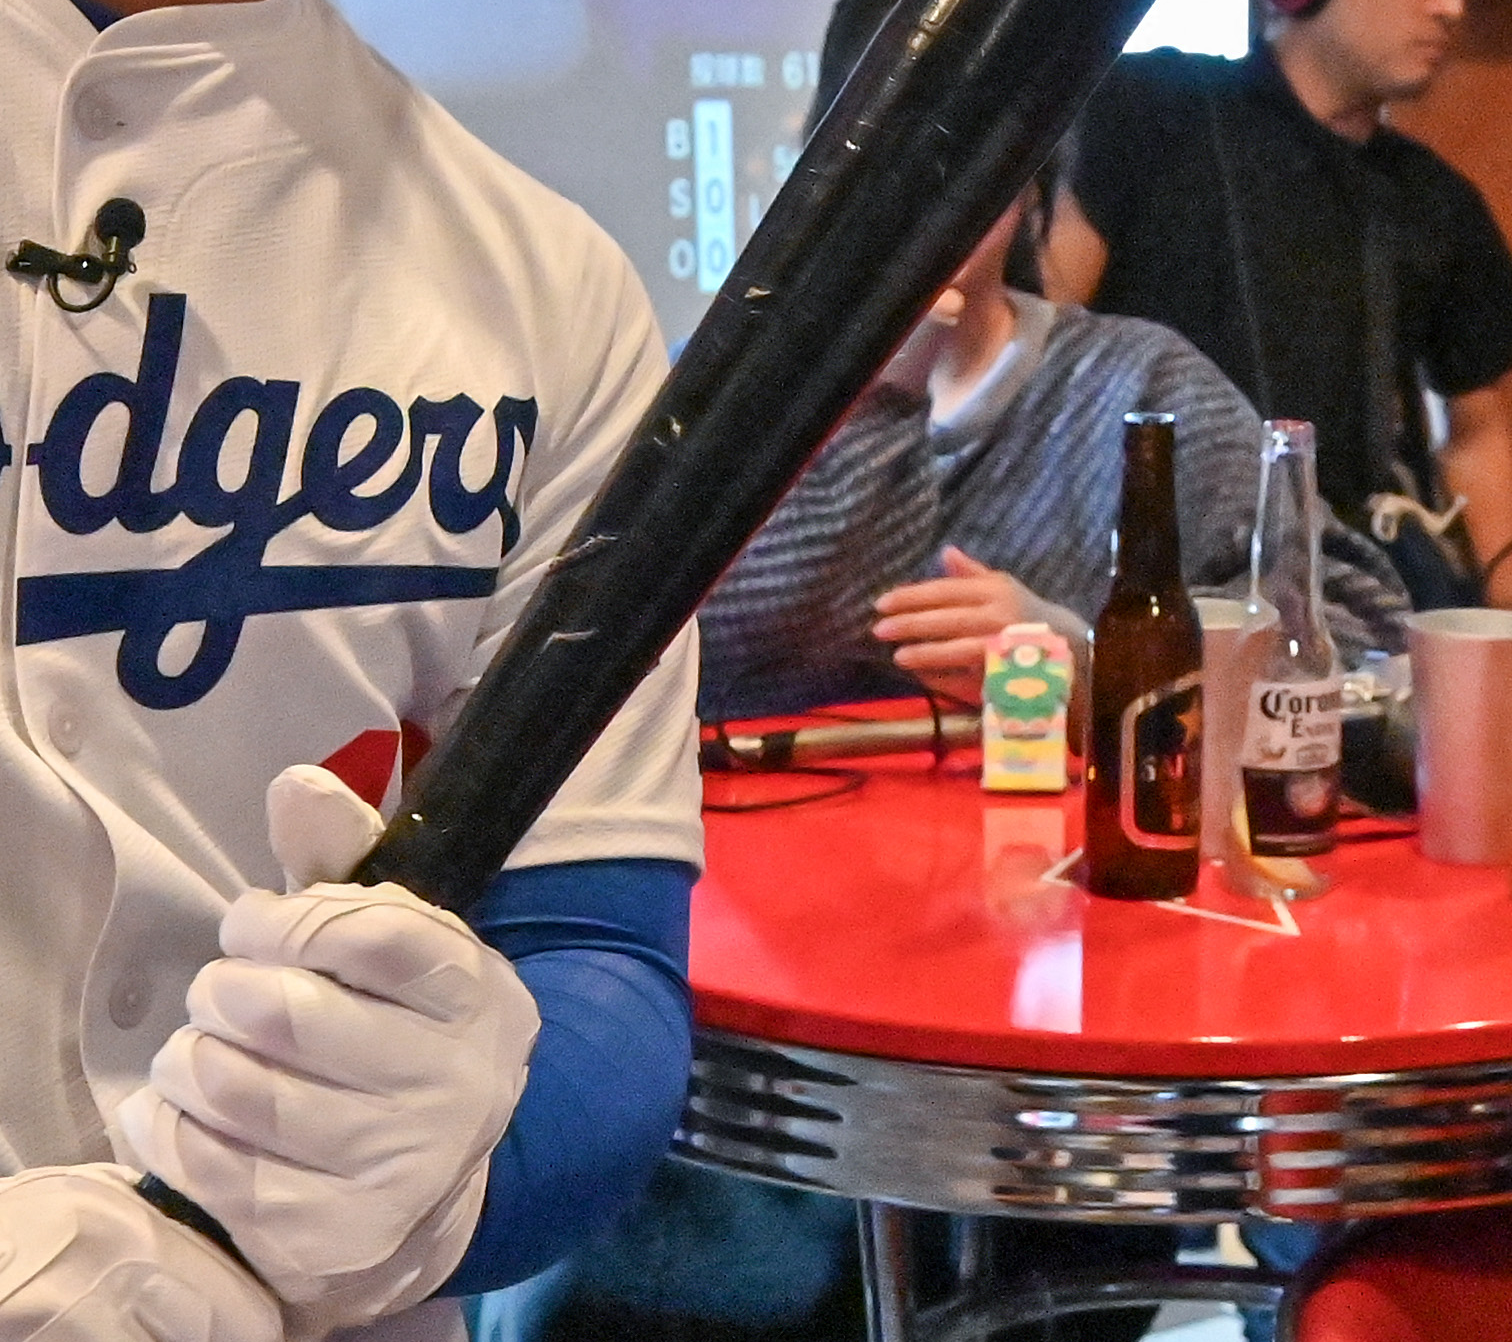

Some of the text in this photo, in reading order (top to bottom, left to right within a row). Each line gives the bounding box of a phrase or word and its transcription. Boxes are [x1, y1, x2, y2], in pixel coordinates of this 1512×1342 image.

[666, 119, 690, 159] B
[668, 177, 726, 219] S 0
[668, 237, 728, 279] O 0
